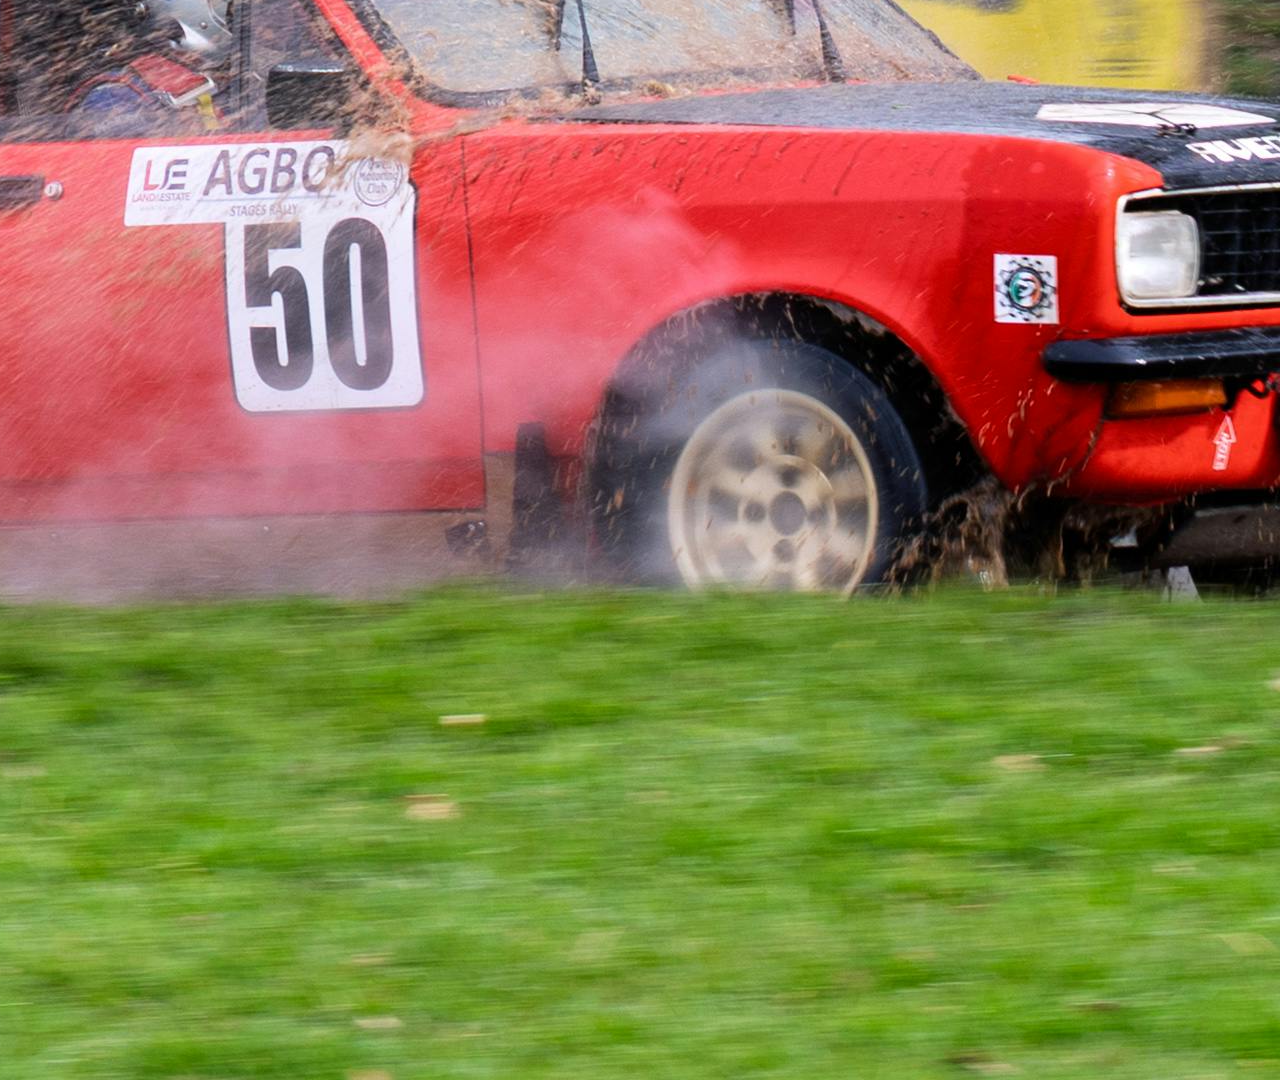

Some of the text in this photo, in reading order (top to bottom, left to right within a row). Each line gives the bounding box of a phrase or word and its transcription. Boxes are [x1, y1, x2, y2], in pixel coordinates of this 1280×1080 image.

[203, 145, 335, 196] AGBO
[230, 204, 266, 217] STAGES
[244, 217, 393, 391] 50
